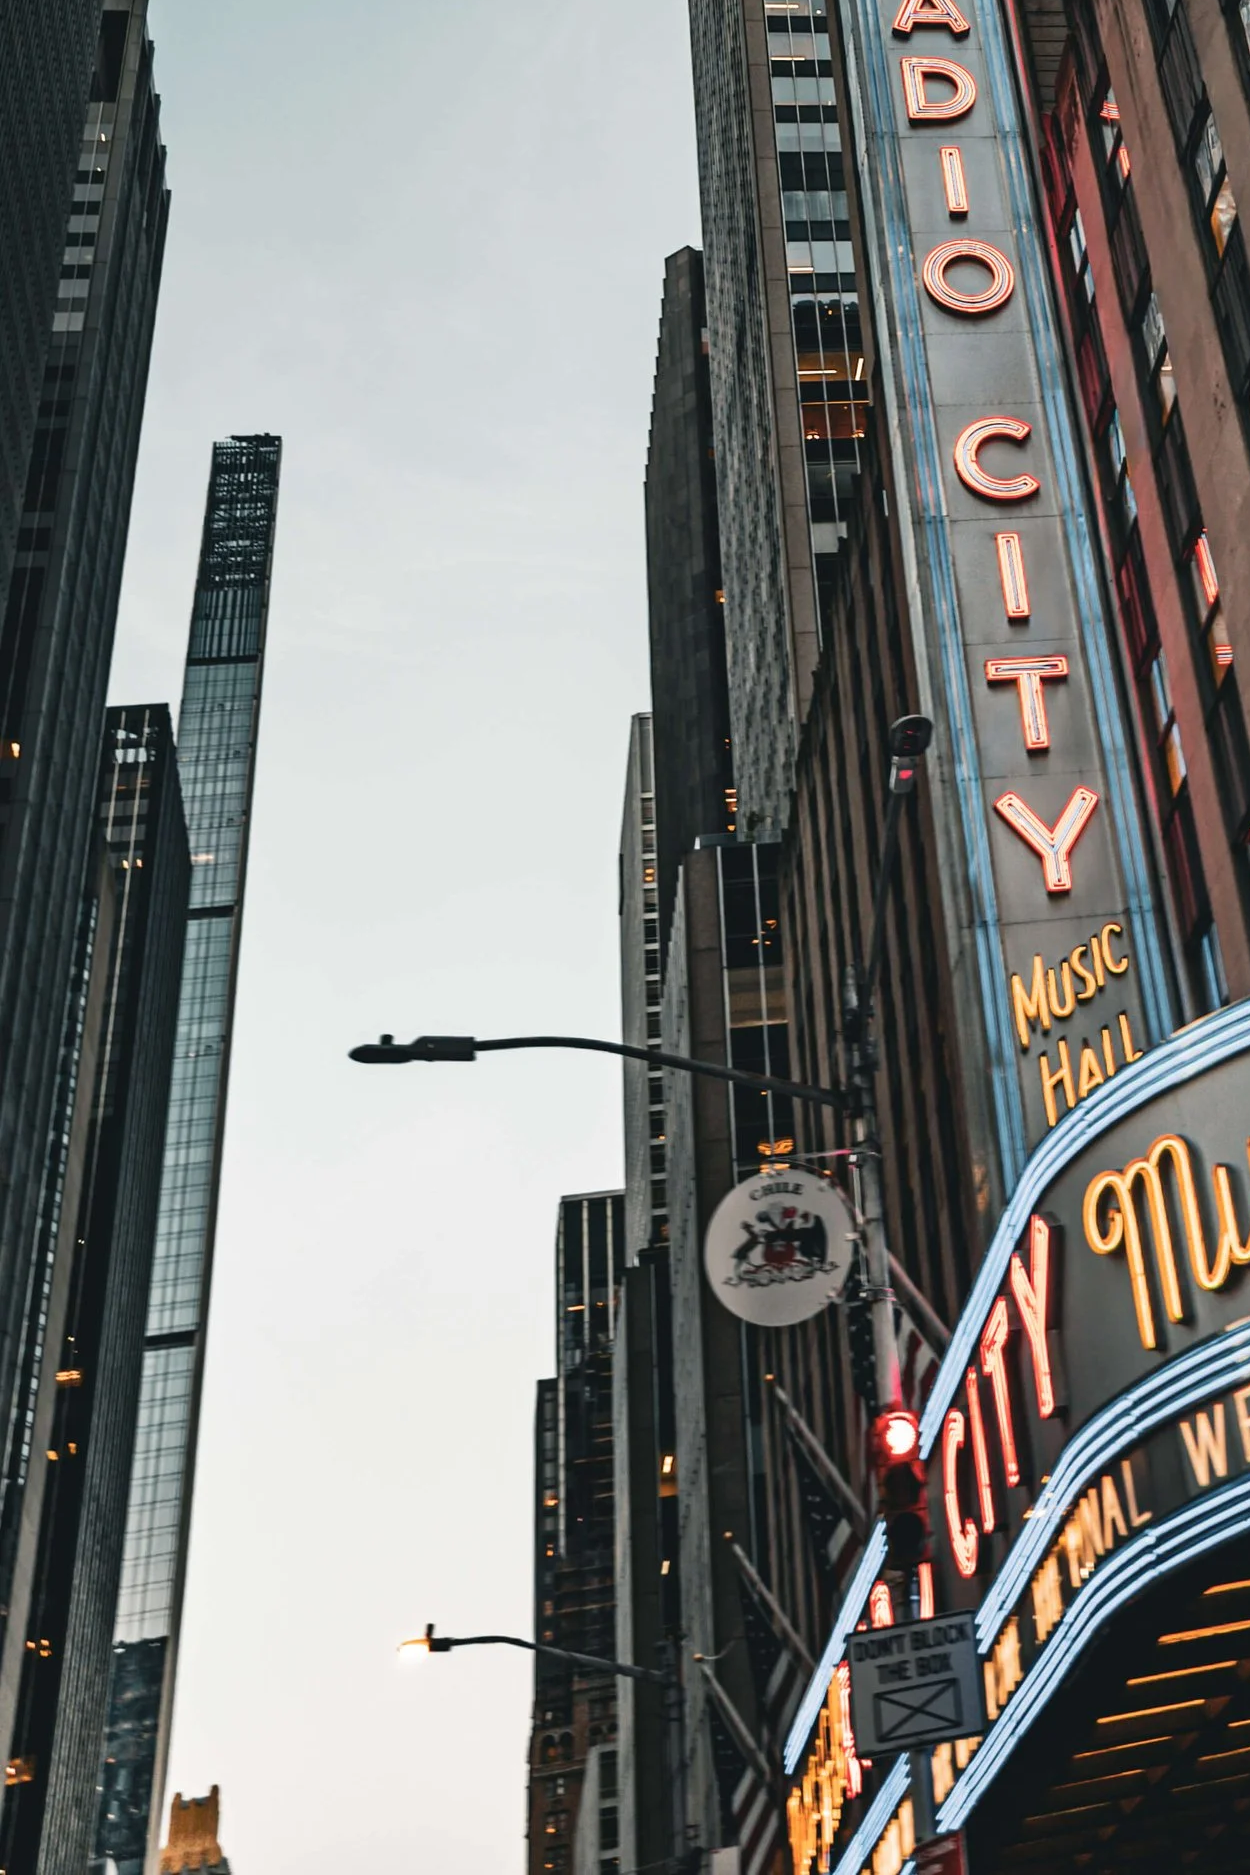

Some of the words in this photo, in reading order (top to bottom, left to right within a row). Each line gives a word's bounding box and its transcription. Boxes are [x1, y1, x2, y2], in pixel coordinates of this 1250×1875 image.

[953, 415, 1101, 894] CITY
[749, 1181, 804, 1201] CHILE
[943, 1213, 1055, 1579] CITY
[910, 1622, 970, 1652] BLOCK
[875, 1659, 912, 1685] THE
[914, 1651, 954, 1677] BOX
